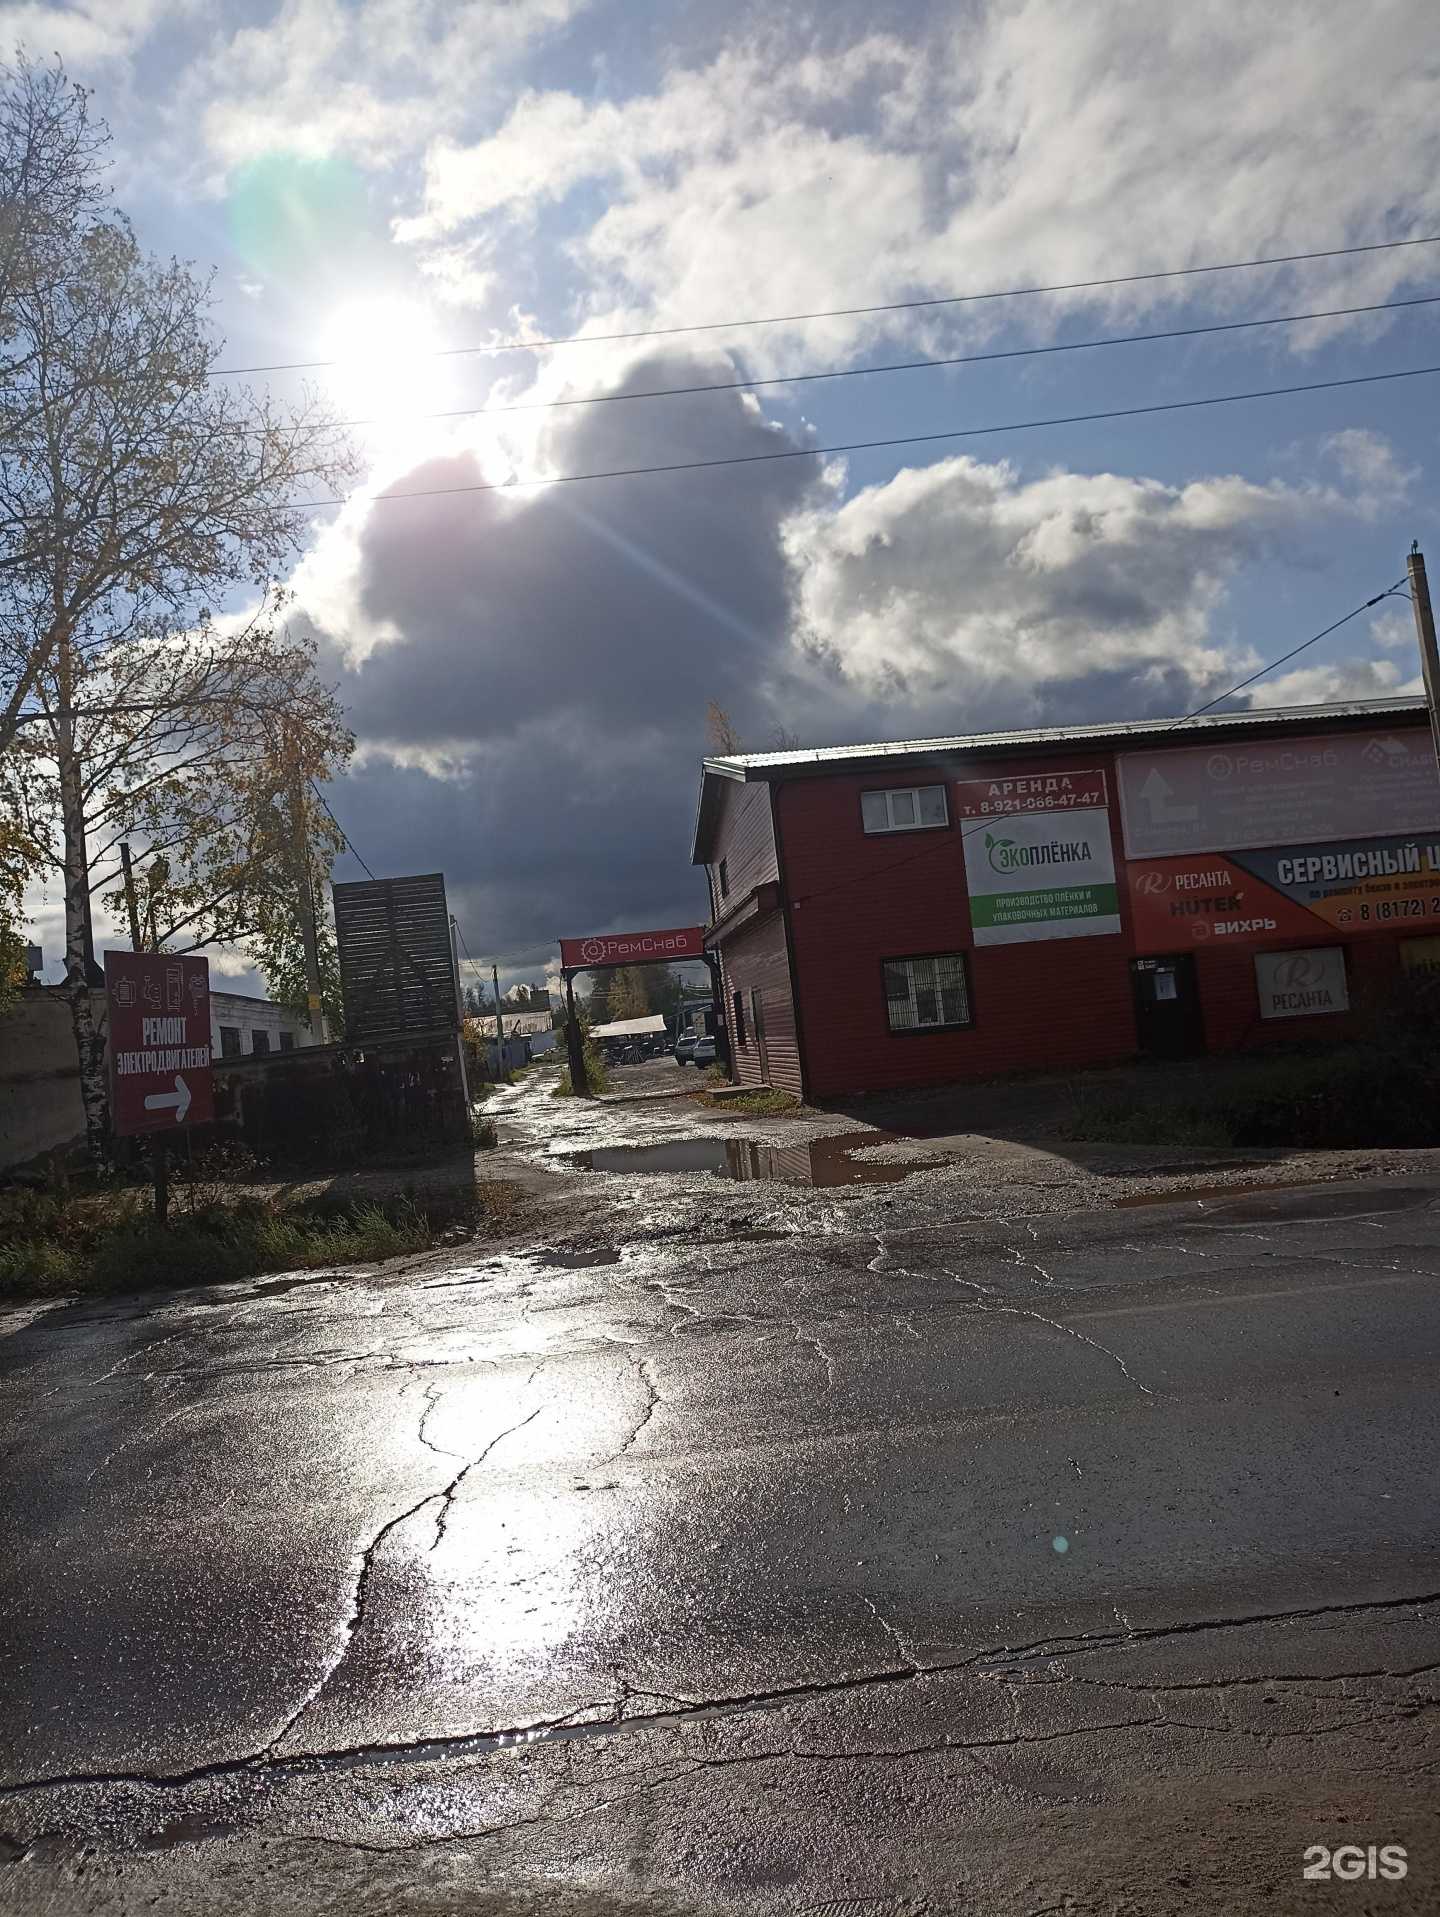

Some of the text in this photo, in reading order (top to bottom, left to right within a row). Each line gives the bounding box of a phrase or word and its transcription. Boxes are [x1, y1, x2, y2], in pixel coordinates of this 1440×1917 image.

[988, 777, 1073, 796] АРЕНДА
[1000, 841, 1092, 867] ЭКОПЛЁНКА
[1277, 843, 1421, 885] СЕРВИСНЫЙ
[1175, 870, 1231, 891] РЕСАНТА
[996, 893, 1054, 908] ПРОИЗВОДСТВО
[1360, 903, 1370, 921] 8
[1376, 899, 1426, 921] (8172)
[992, 903, 1098, 922] УПАКОВОЧНЫХ МАТЕРИАЛОВ
[607, 935, 687, 955] РемСнаб
[1272, 990, 1333, 1010] РЕСАНТА
[142, 1017, 187, 1046] РЕМОНТ
[117, 1044, 210, 1075] ЭЛЕКТРОДВИГАТЕЛЕЙ
